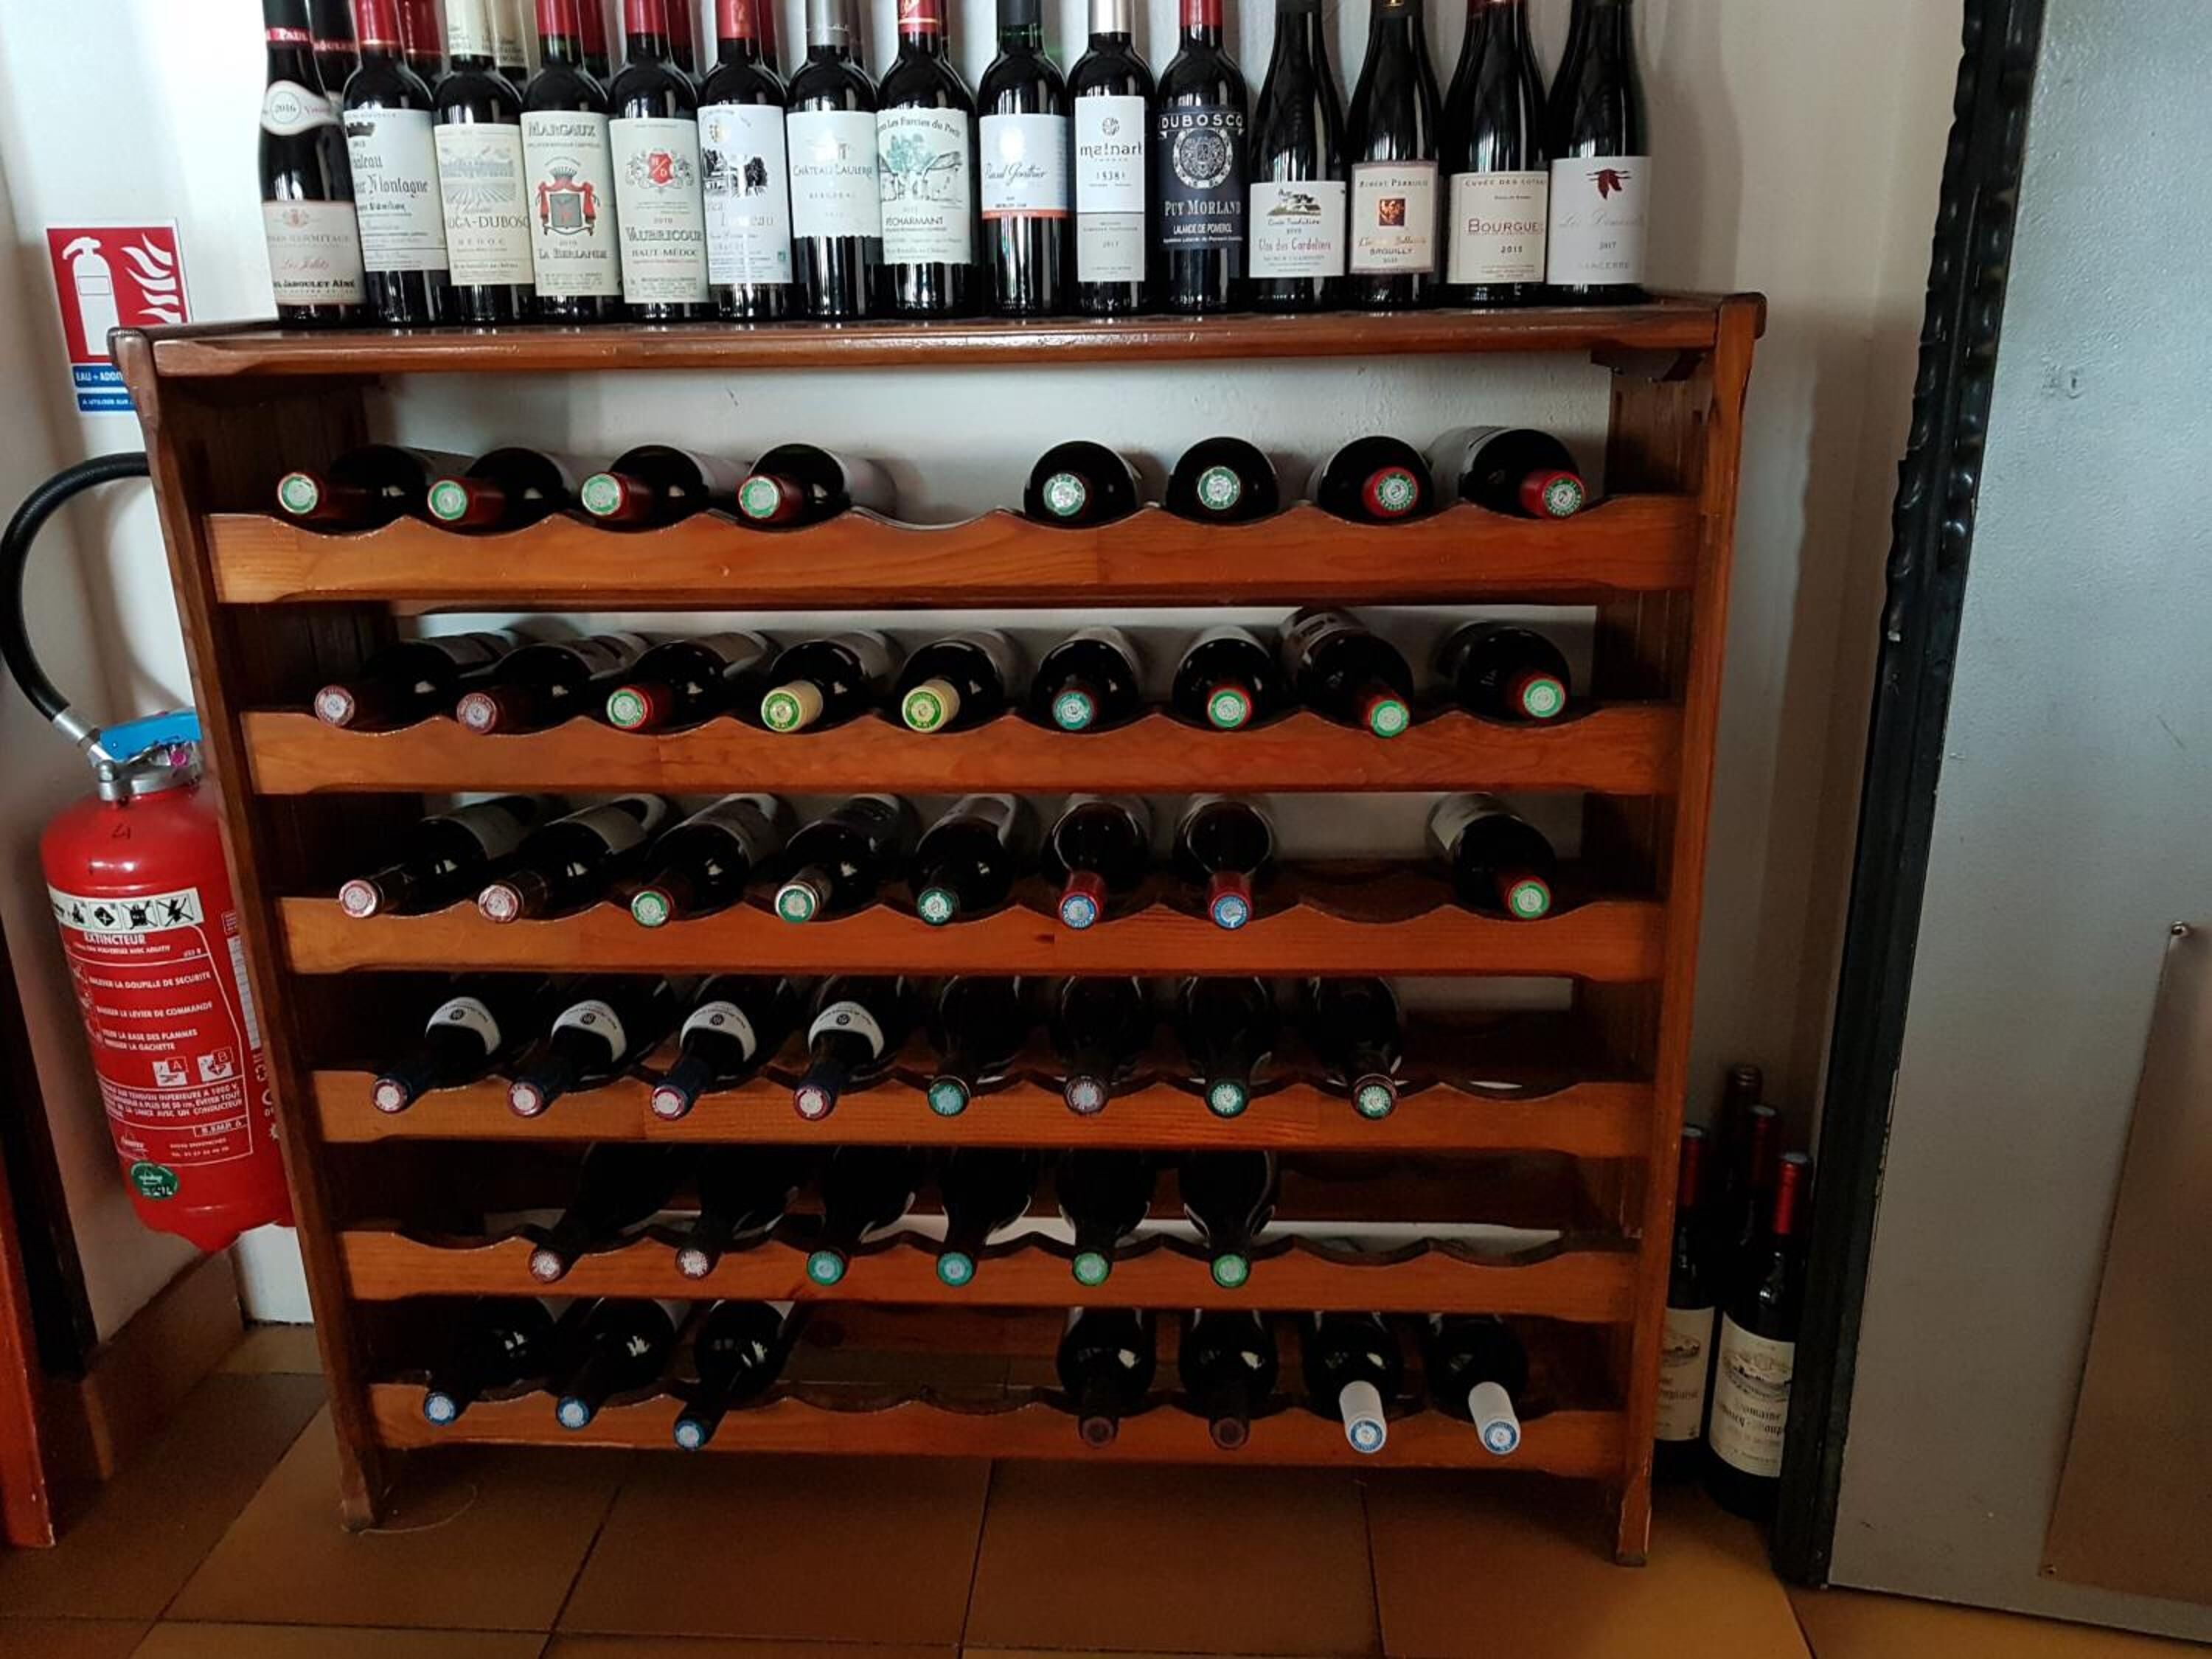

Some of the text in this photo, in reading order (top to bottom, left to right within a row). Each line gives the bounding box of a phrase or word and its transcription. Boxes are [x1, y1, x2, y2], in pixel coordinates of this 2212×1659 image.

[1161, 114, 1242, 129] DUBOSCQ
[529, 121, 596, 137] MARGAUX
[1164, 201, 1186, 217] PUY
[83, 932, 147, 945] EXTINCTEUR
[163, 978, 174, 987] DE
[154, 1009, 164, 1018] DE
